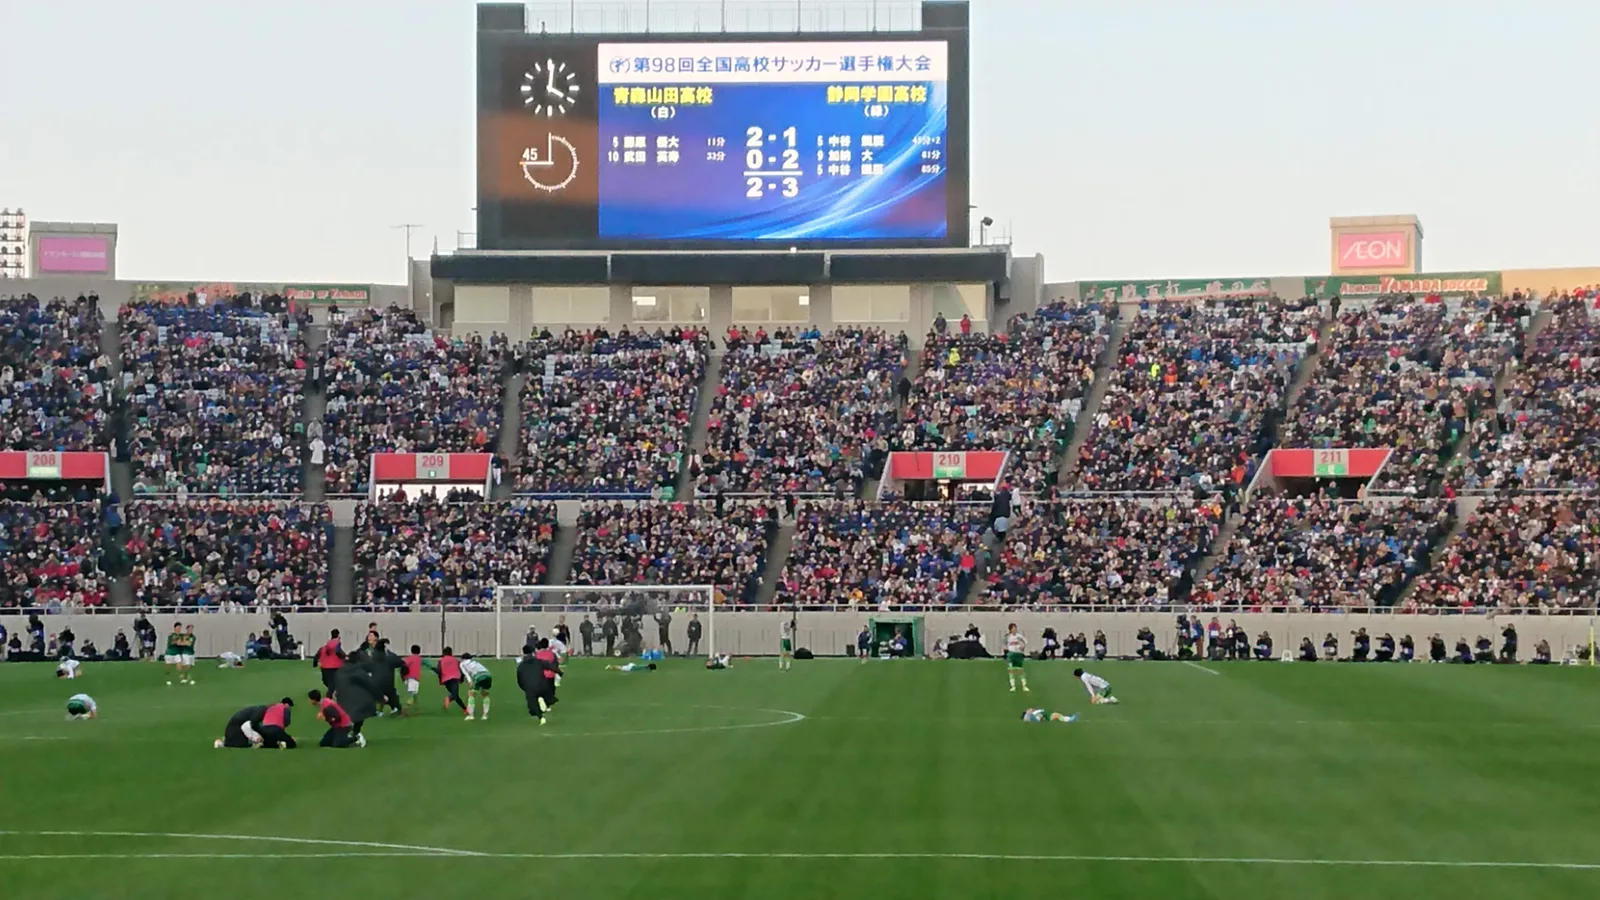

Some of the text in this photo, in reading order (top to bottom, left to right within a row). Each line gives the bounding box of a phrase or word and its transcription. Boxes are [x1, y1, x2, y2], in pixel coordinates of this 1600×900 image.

[633, 55, 931, 73] 第98回全国高校サッカー選手権大会
[522, 148, 538, 161] 45
[608, 151, 619, 162] 10
[33, 454, 56, 466] 208
[422, 455, 444, 467] 209
[938, 454, 960, 466] 210
[1320, 451, 1341, 463] 211
